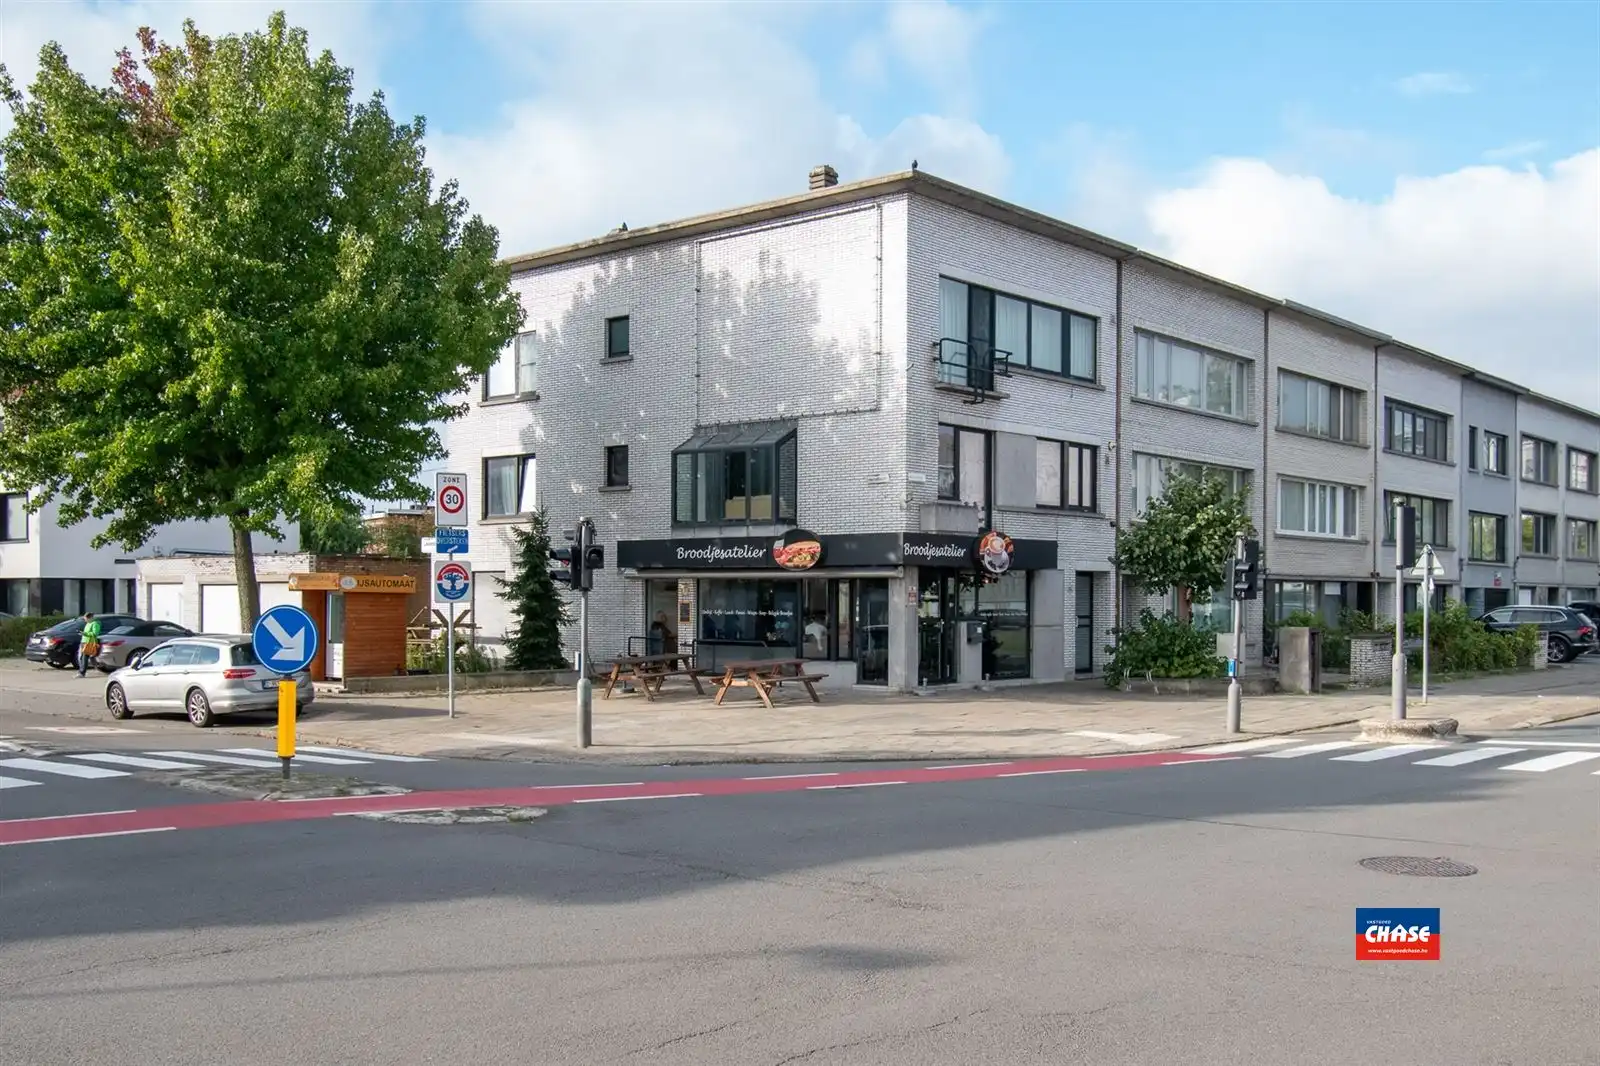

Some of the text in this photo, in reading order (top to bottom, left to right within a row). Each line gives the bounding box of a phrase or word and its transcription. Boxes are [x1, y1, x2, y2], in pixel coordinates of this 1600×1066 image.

[445, 494, 459, 504] 30
[676, 544, 766, 563] Broodjesatelier
[903, 542, 966, 560] Broodjesatelier
[357, 579, 415, 588] IJSAUTOMAAT
